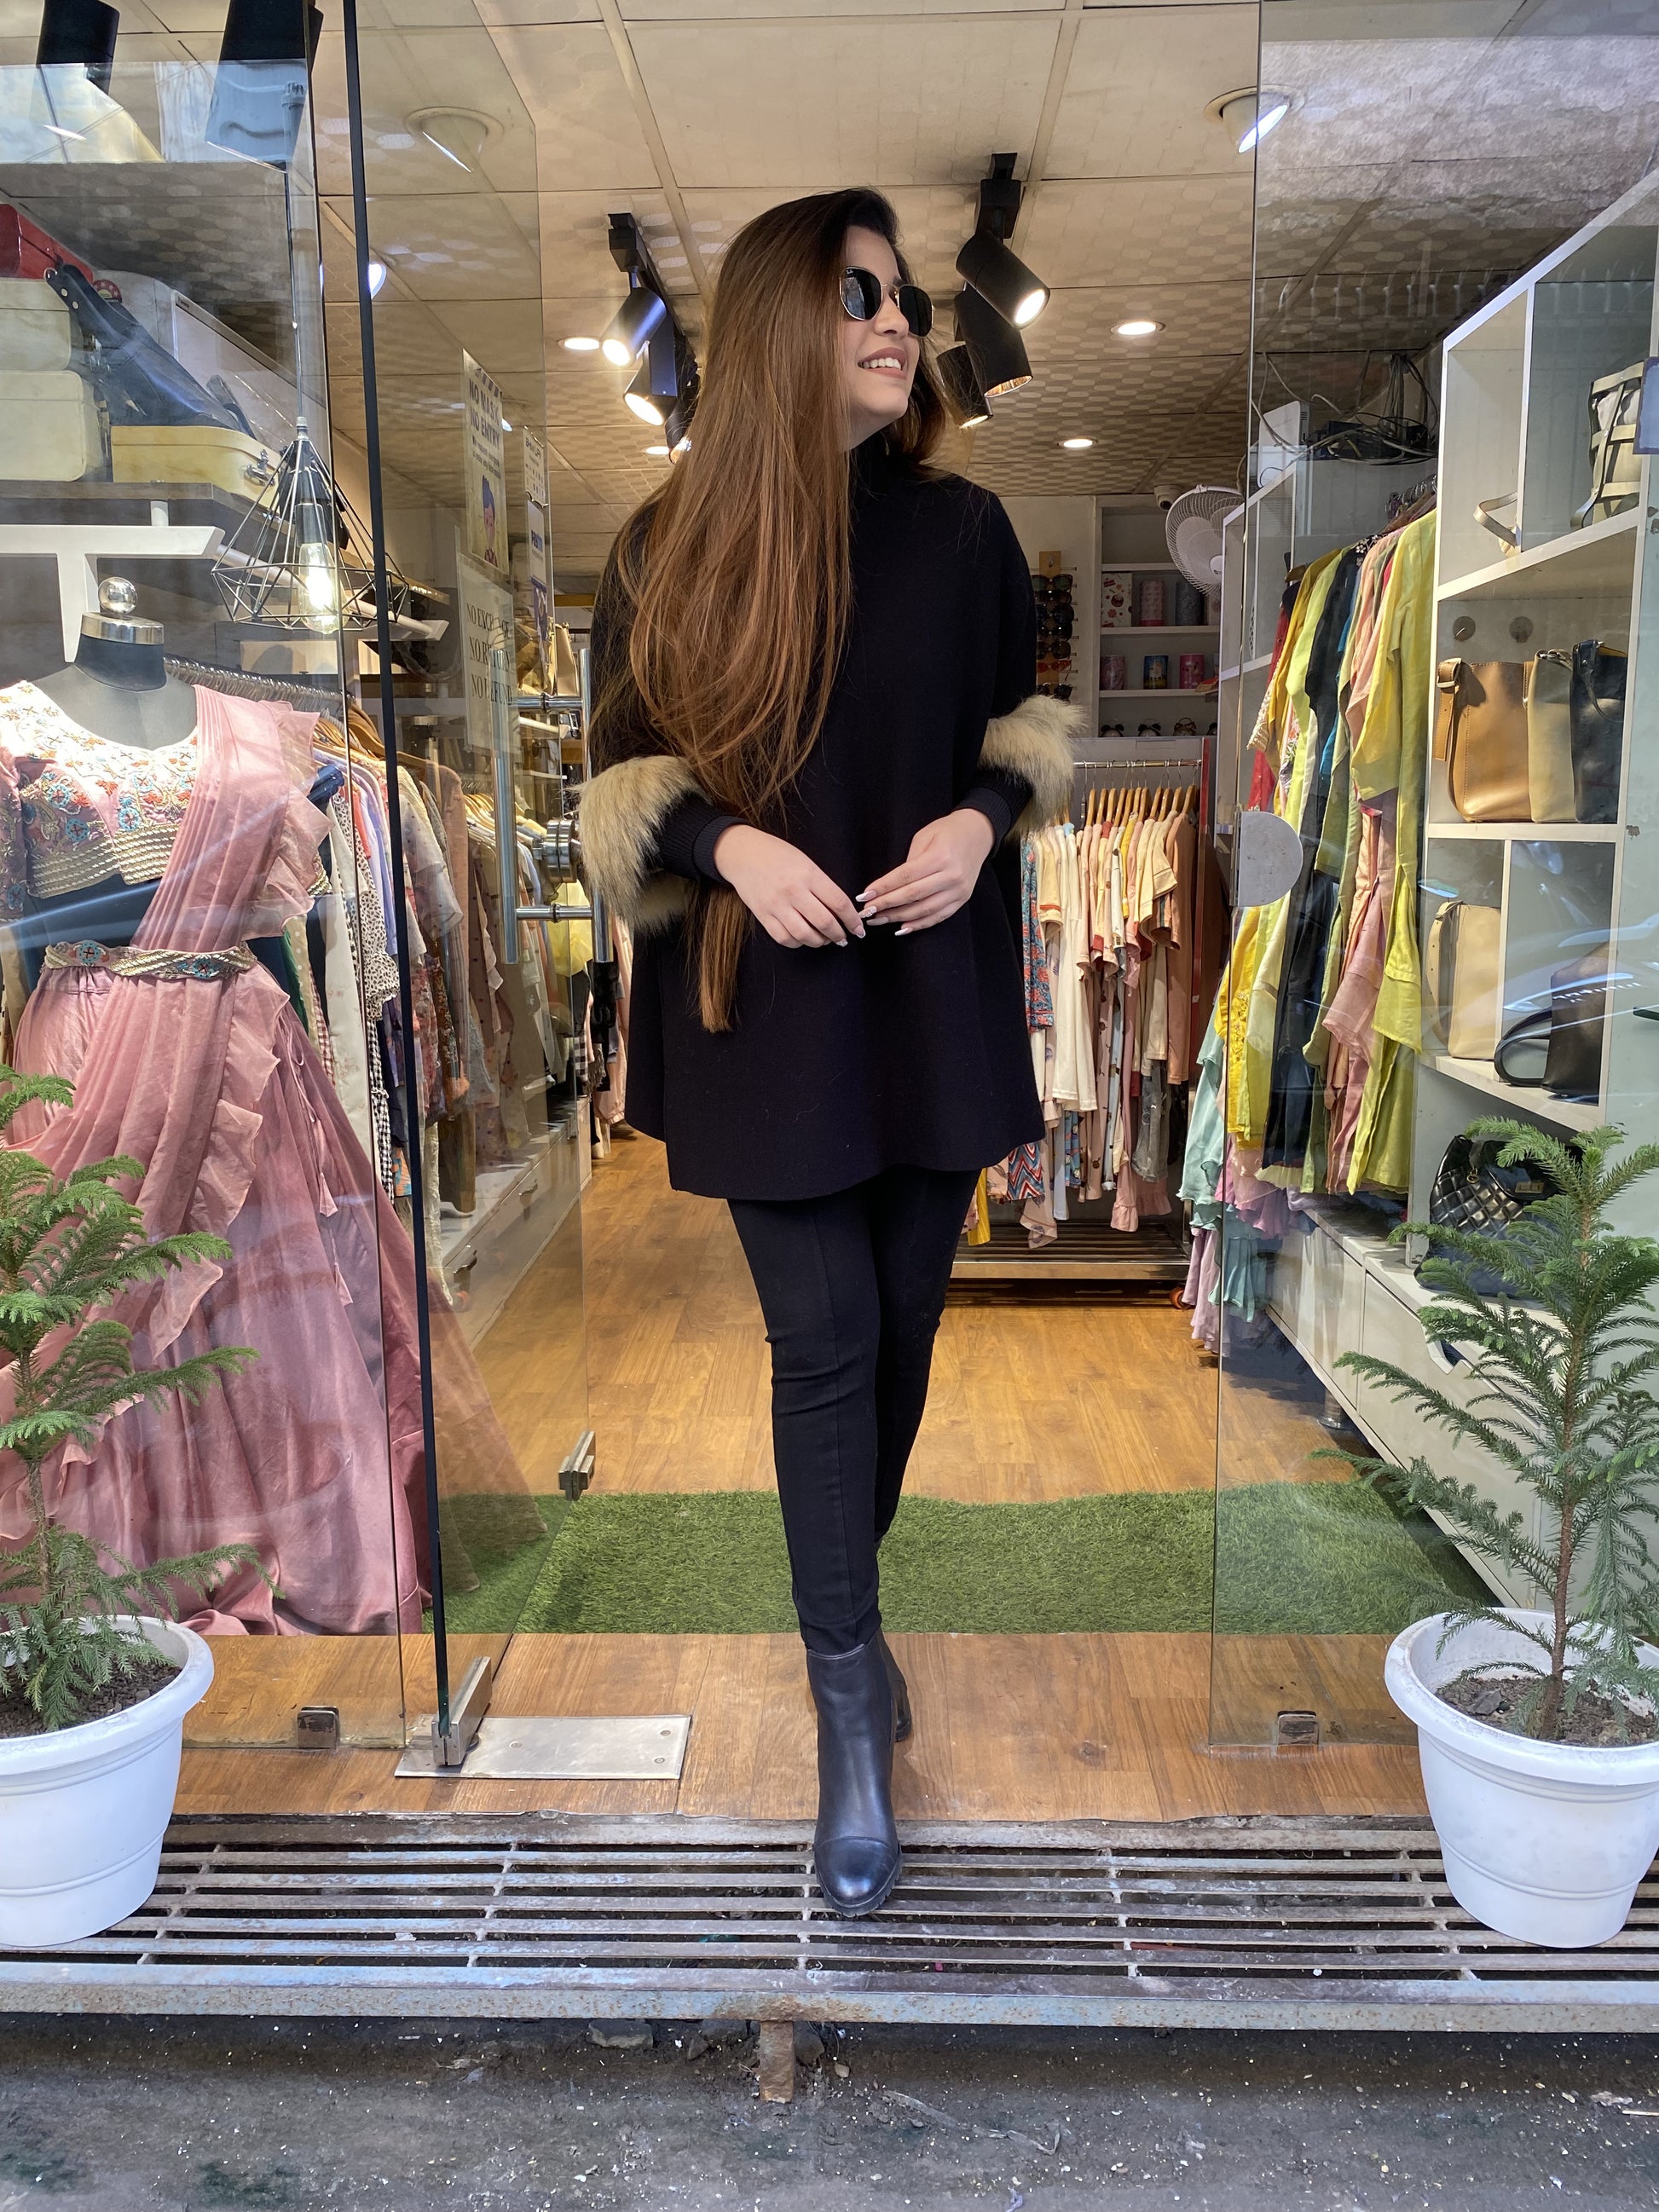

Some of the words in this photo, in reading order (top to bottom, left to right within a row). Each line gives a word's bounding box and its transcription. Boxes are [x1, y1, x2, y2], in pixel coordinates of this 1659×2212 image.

[470, 378, 479, 404] NO
[480, 390, 500, 426] MASK
[471, 407, 479, 431] NO
[481, 415, 500, 451] ENTRY
[466, 602, 477, 625] NO
[477, 607, 512, 640] EXCHGE
[469, 635, 481, 662] NO
[483, 641, 511, 672] RTUN
[471, 673, 483, 699] NO
